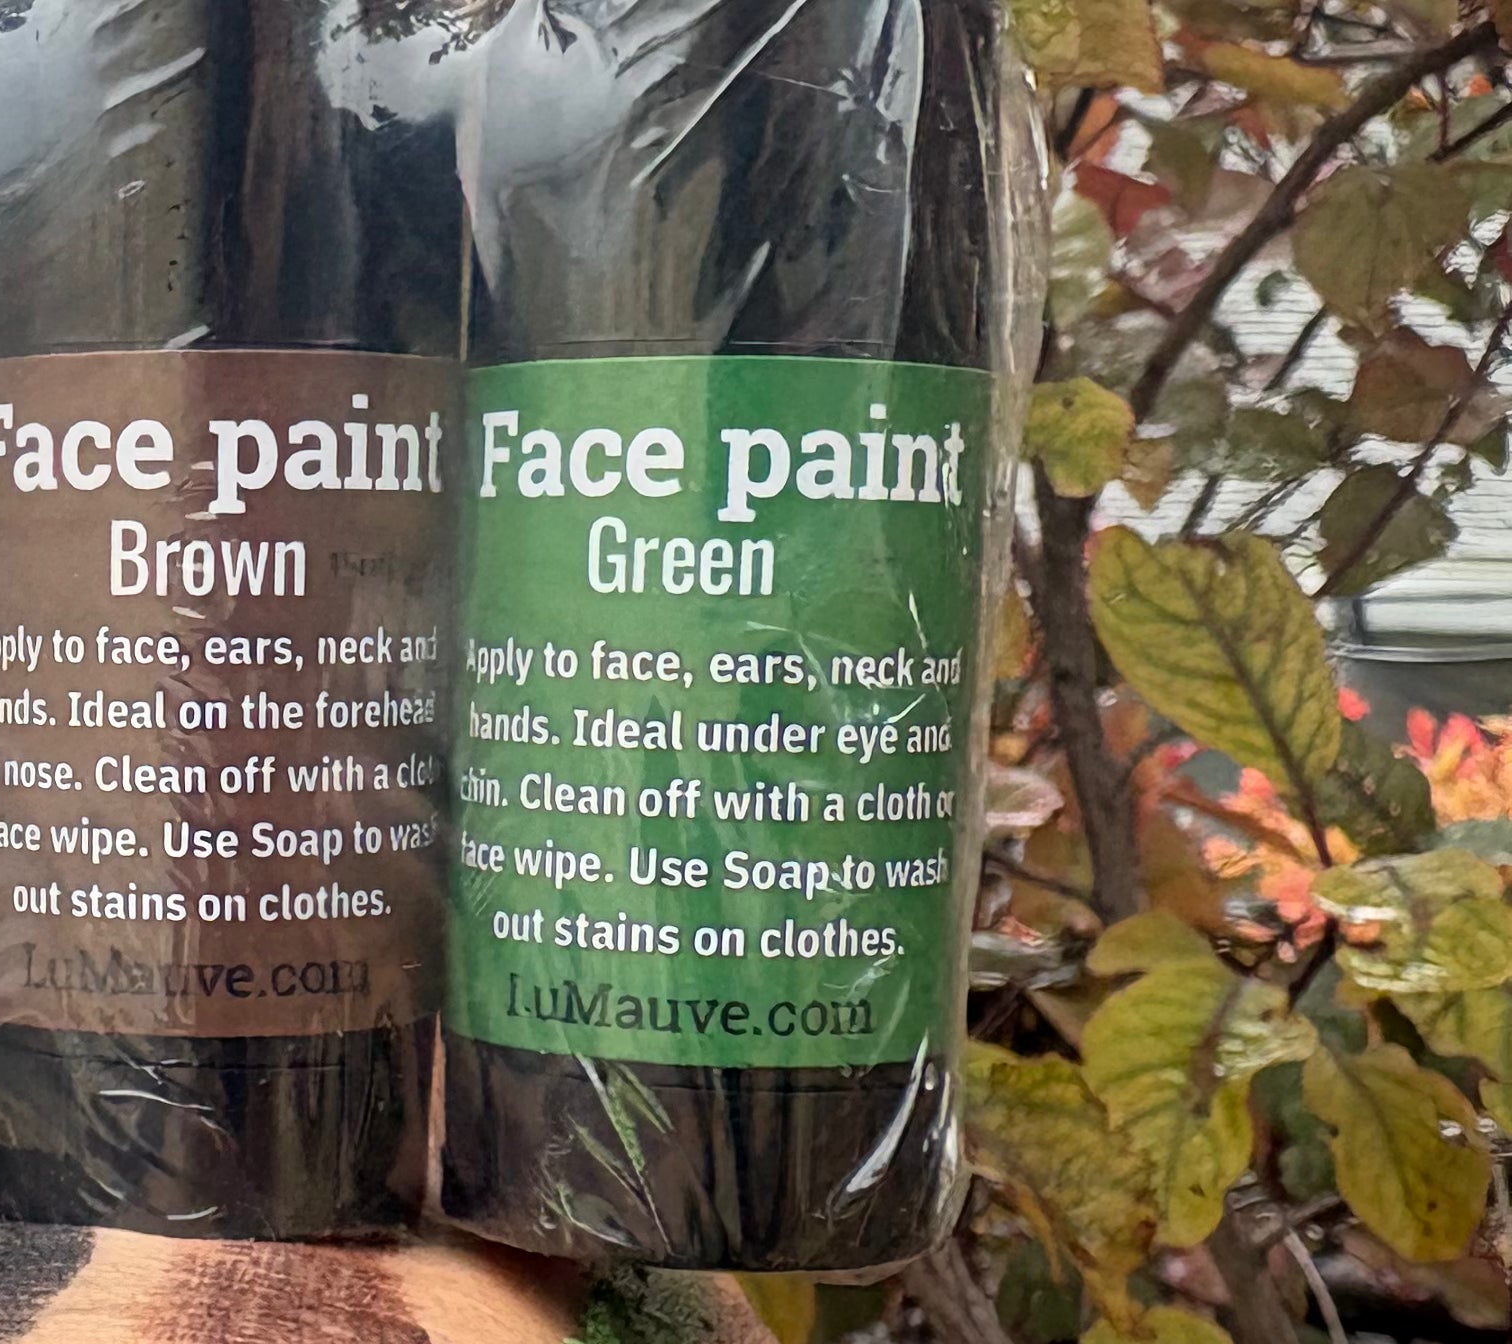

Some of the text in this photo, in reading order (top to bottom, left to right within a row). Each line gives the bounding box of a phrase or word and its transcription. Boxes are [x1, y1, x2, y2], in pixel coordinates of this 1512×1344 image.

[208, 393, 442, 514] paint
[479, 403, 965, 523] Face paint
[109, 519, 306, 597] Brown
[588, 515, 775, 596] Green
[52, 629, 85, 664] to
[95, 626, 191, 671] face,
[204, 635, 304, 671] ears,
[317, 625, 393, 664] neck
[466, 636, 962, 692] Apply to face, ears, neck and
[68, 690, 166, 729] Ideal
[179, 700, 227, 730] on
[241, 691, 304, 730] the
[469, 701, 952, 764] hands. Ideal under eye and
[4, 759, 83, 791] nose.
[95, 754, 206, 794] Clean
[219, 755, 276, 794] off
[288, 755, 364, 792] with
[373, 763, 389, 790] a
[460, 767, 508, 807] chin.
[519, 772, 626, 816] Clean
[639, 778, 701, 819] off
[714, 781, 808, 822] with
[823, 792, 845, 822] a
[857, 782, 931, 822] cloth
[50, 816, 149, 865] wipe.
[163, 821, 238, 858] Use
[251, 821, 343, 865] Soap
[353, 820, 382, 855] to
[514, 839, 614, 890] wipe.
[629, 846, 709, 888] Use
[723, 850, 830, 901] Soap
[840, 854, 876, 890] to
[13, 881, 391, 922] out stains on clothes.
[493, 909, 906, 958] out stains on clothes.
[506, 972, 874, 1036] LuMauve.com
